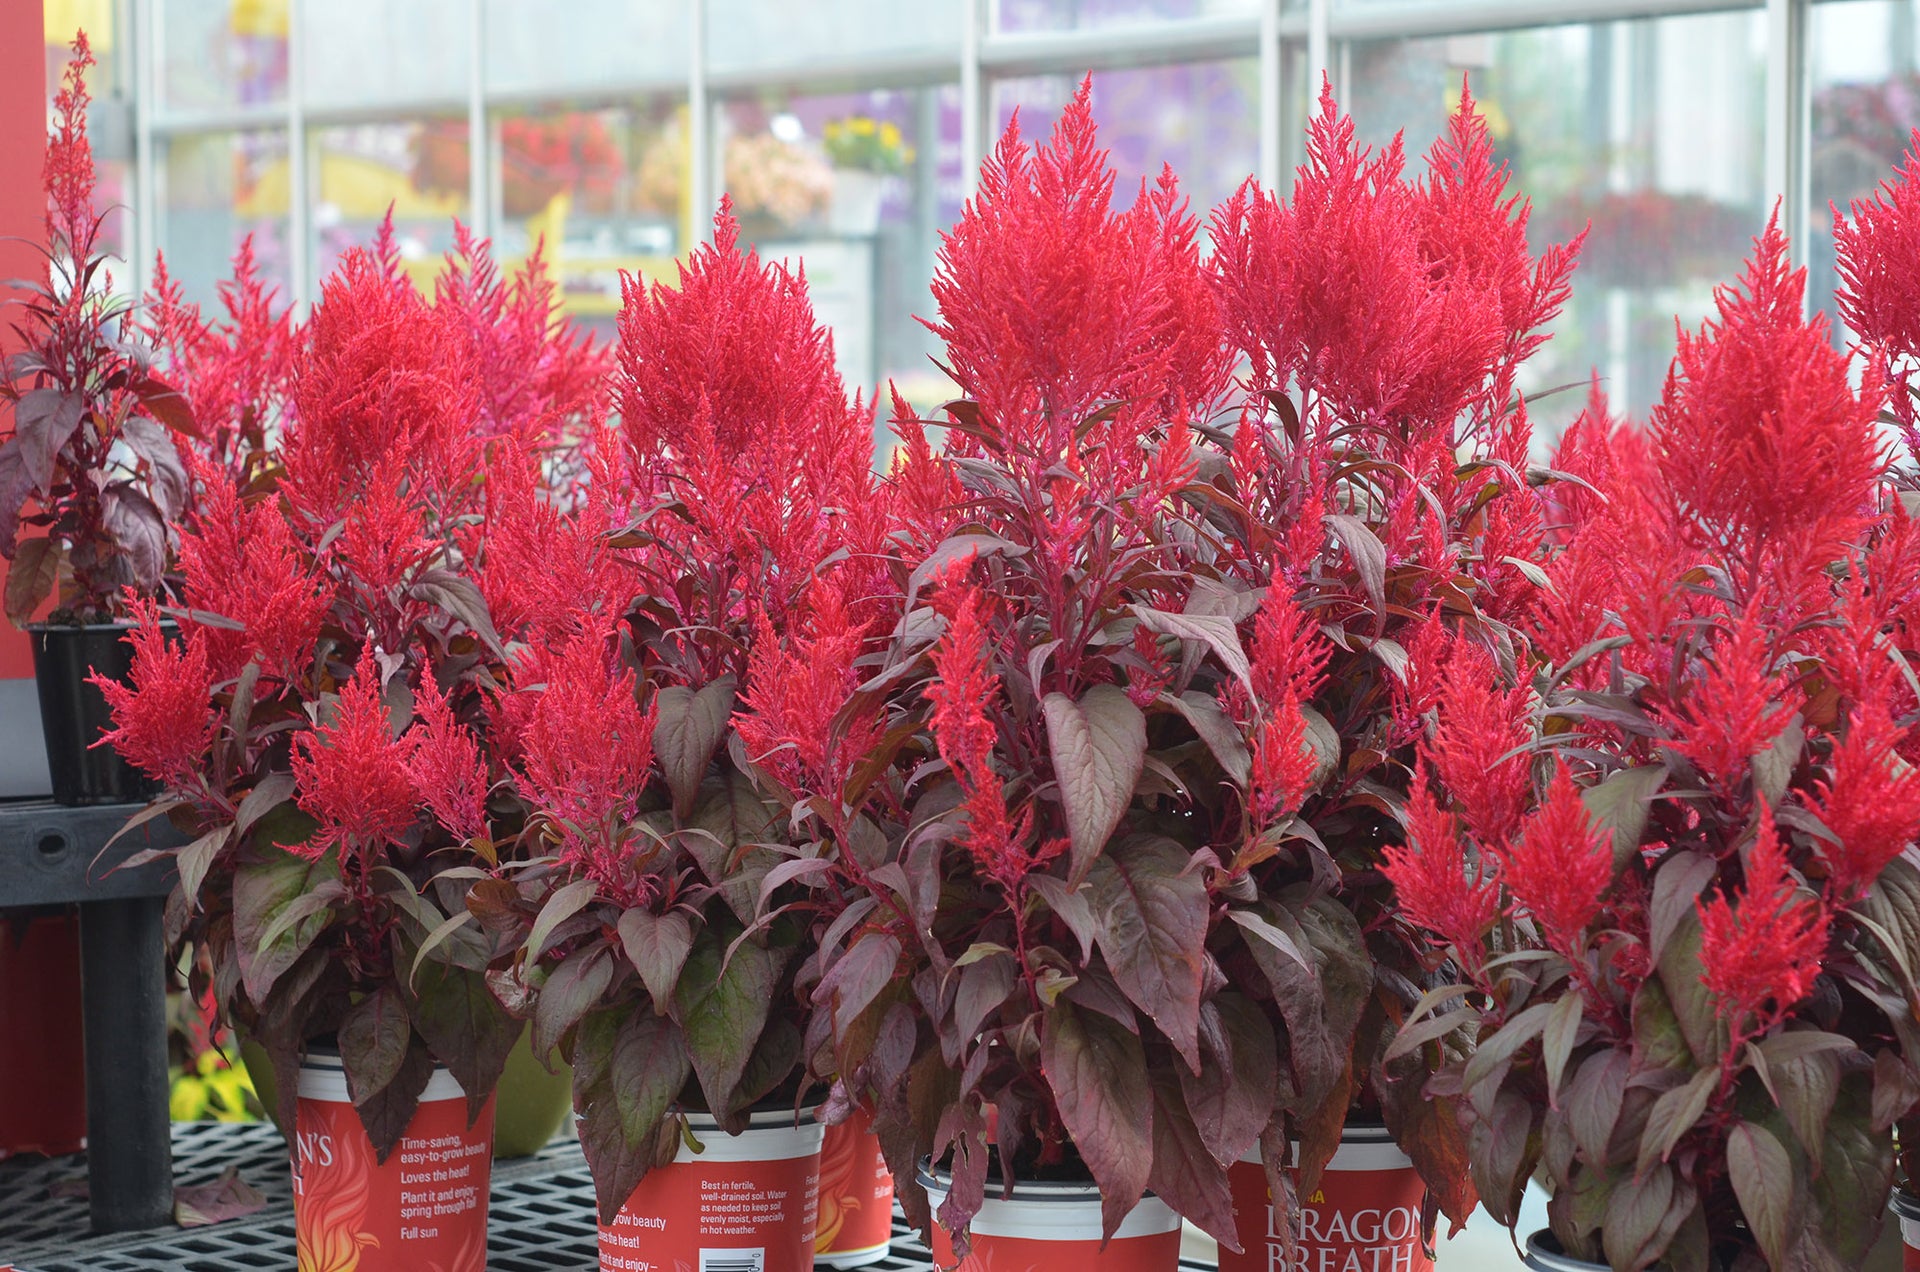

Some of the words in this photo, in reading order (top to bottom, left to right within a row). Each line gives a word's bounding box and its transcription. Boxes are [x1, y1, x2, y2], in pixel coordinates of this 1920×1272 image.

[400, 1134, 462, 1149] Time-saving,
[400, 1148, 464, 1164] easy-to-grow
[401, 1172, 431, 1184] Loves
[433, 1169, 447, 1182] the
[449, 1164, 470, 1179] heat!
[701, 1180, 720, 1190] Best
[722, 1181, 730, 1190] in
[731, 1181, 756, 1190] fertile,
[401, 1191, 427, 1204] Plant
[429, 1190, 436, 1202] it
[437, 1187, 454, 1201] and
[701, 1192, 750, 1201] well-drained
[752, 1191, 766, 1201] soil.
[767, 1190, 787, 1200] Water
[401, 1204, 432, 1219] spring
[434, 1200, 465, 1215] through
[701, 1204, 710, 1212] as
[712, 1203, 741, 1212] needed
[742, 1203, 750, 1212] to
[752, 1202, 769, 1213] keep
[770, 1201, 782, 1211] soil
[632, 1212, 666, 1232] beauty
[701, 1214, 726, 1225] evenly
[728, 1214, 751, 1224] moist,
[752, 1211, 785, 1224] especially
[401, 1226, 418, 1239] Full
[420, 1227, 438, 1238] sun
[700, 1225, 708, 1234] in
[709, 1225, 722, 1235] hot
[724, 1224, 756, 1235] weather.
[618, 1233, 640, 1249] heat!
[625, 1257, 649, 1272] enjoy
[1265, 1242, 1415, 1272] BREATH
